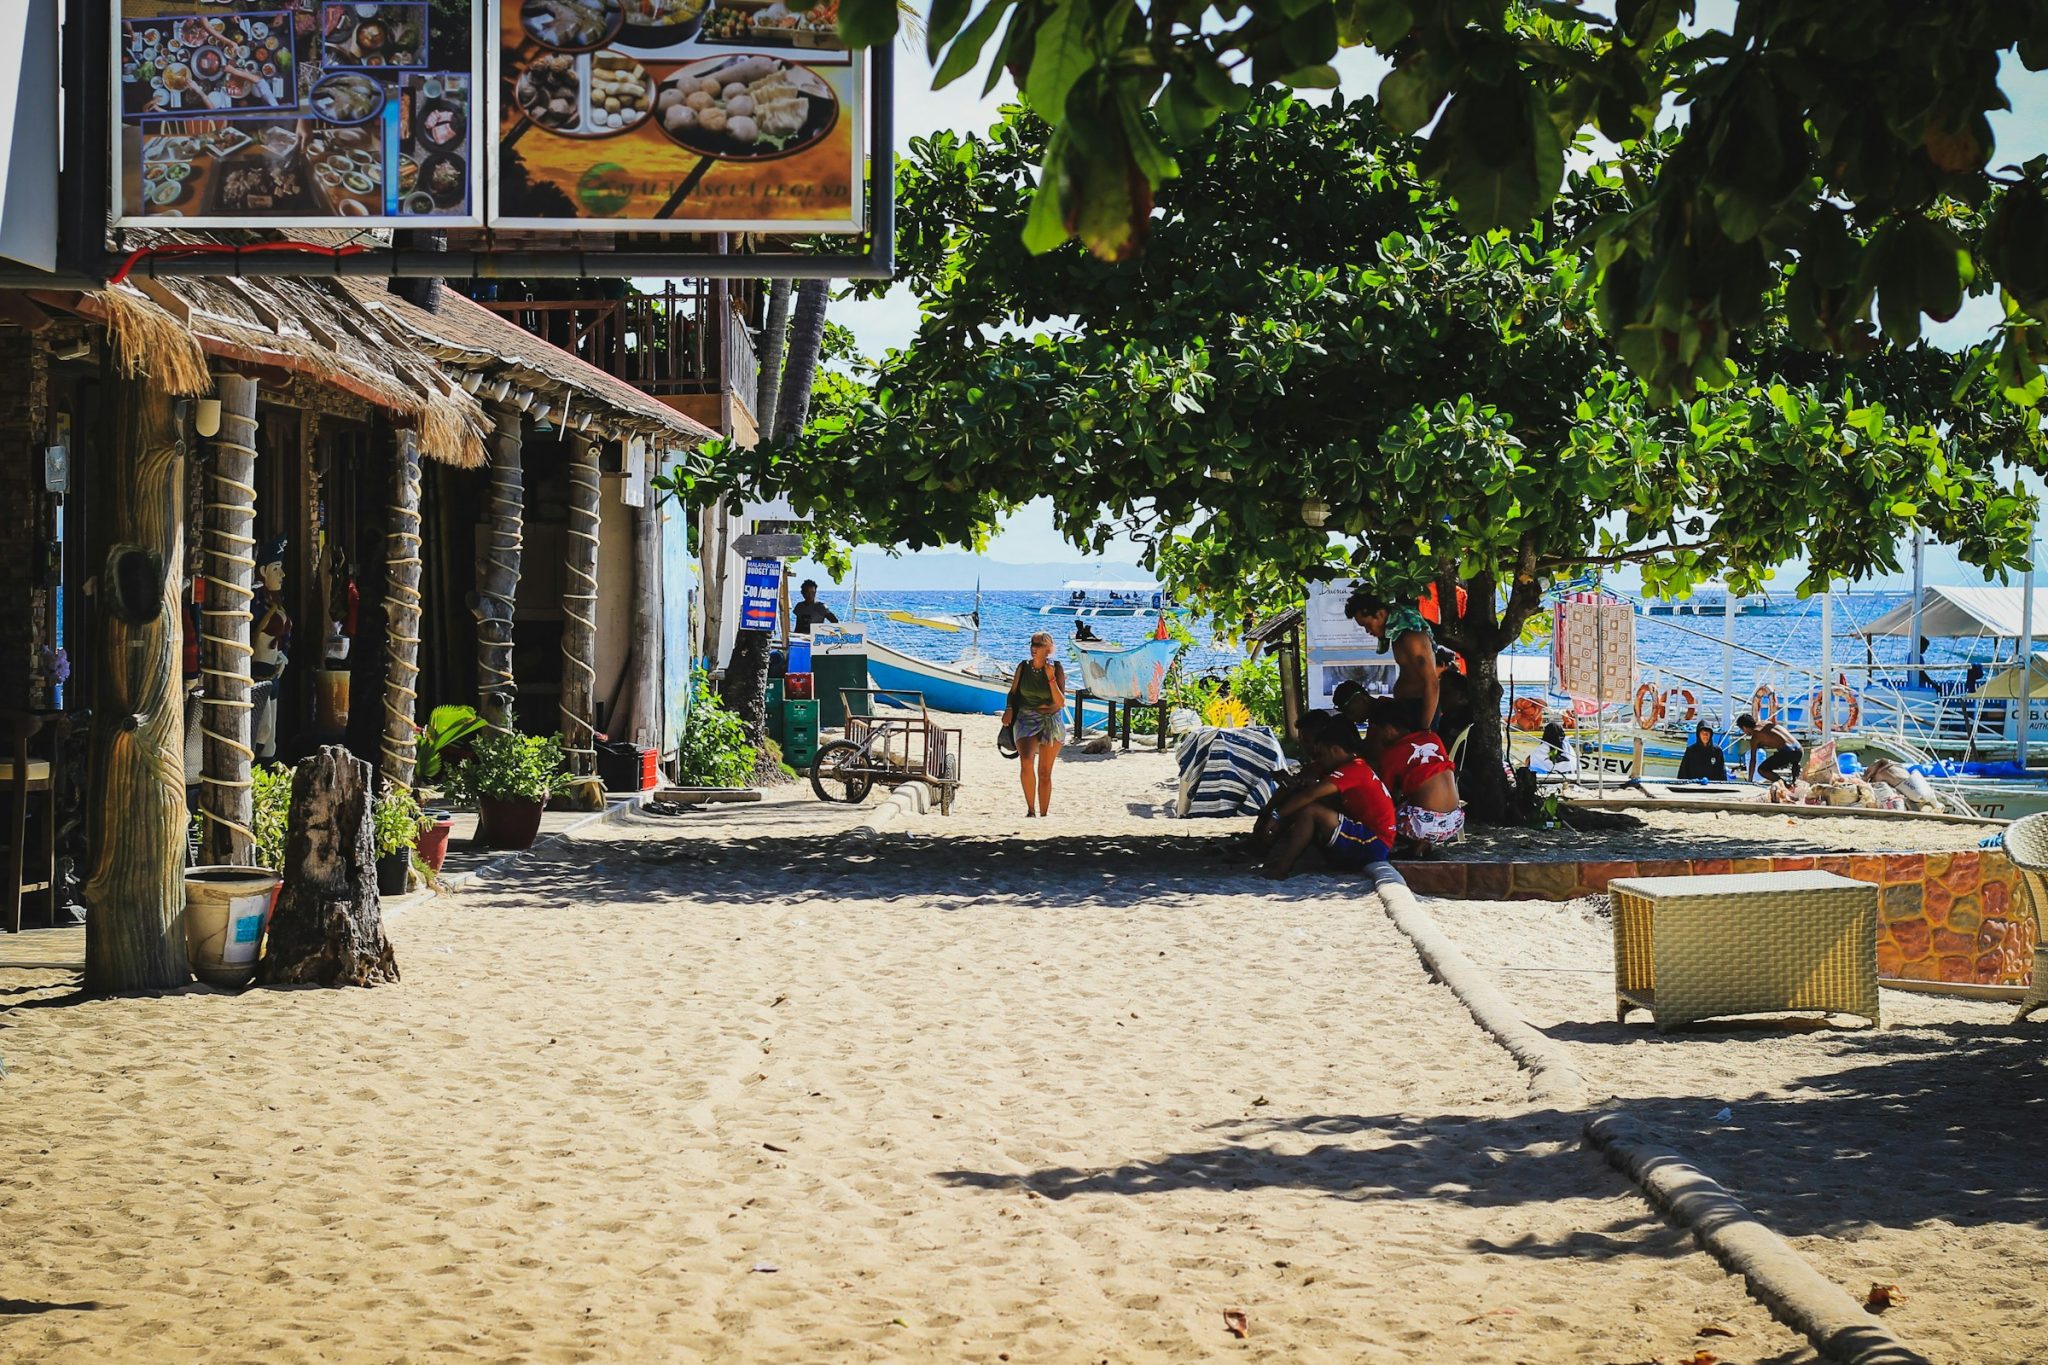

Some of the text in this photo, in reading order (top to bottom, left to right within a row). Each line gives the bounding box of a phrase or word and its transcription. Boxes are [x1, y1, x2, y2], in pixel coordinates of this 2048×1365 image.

[747, 567, 780, 576] BUDGET INN
[744, 584, 758, 598] 500
[745, 619, 773, 628] THIS WAY
